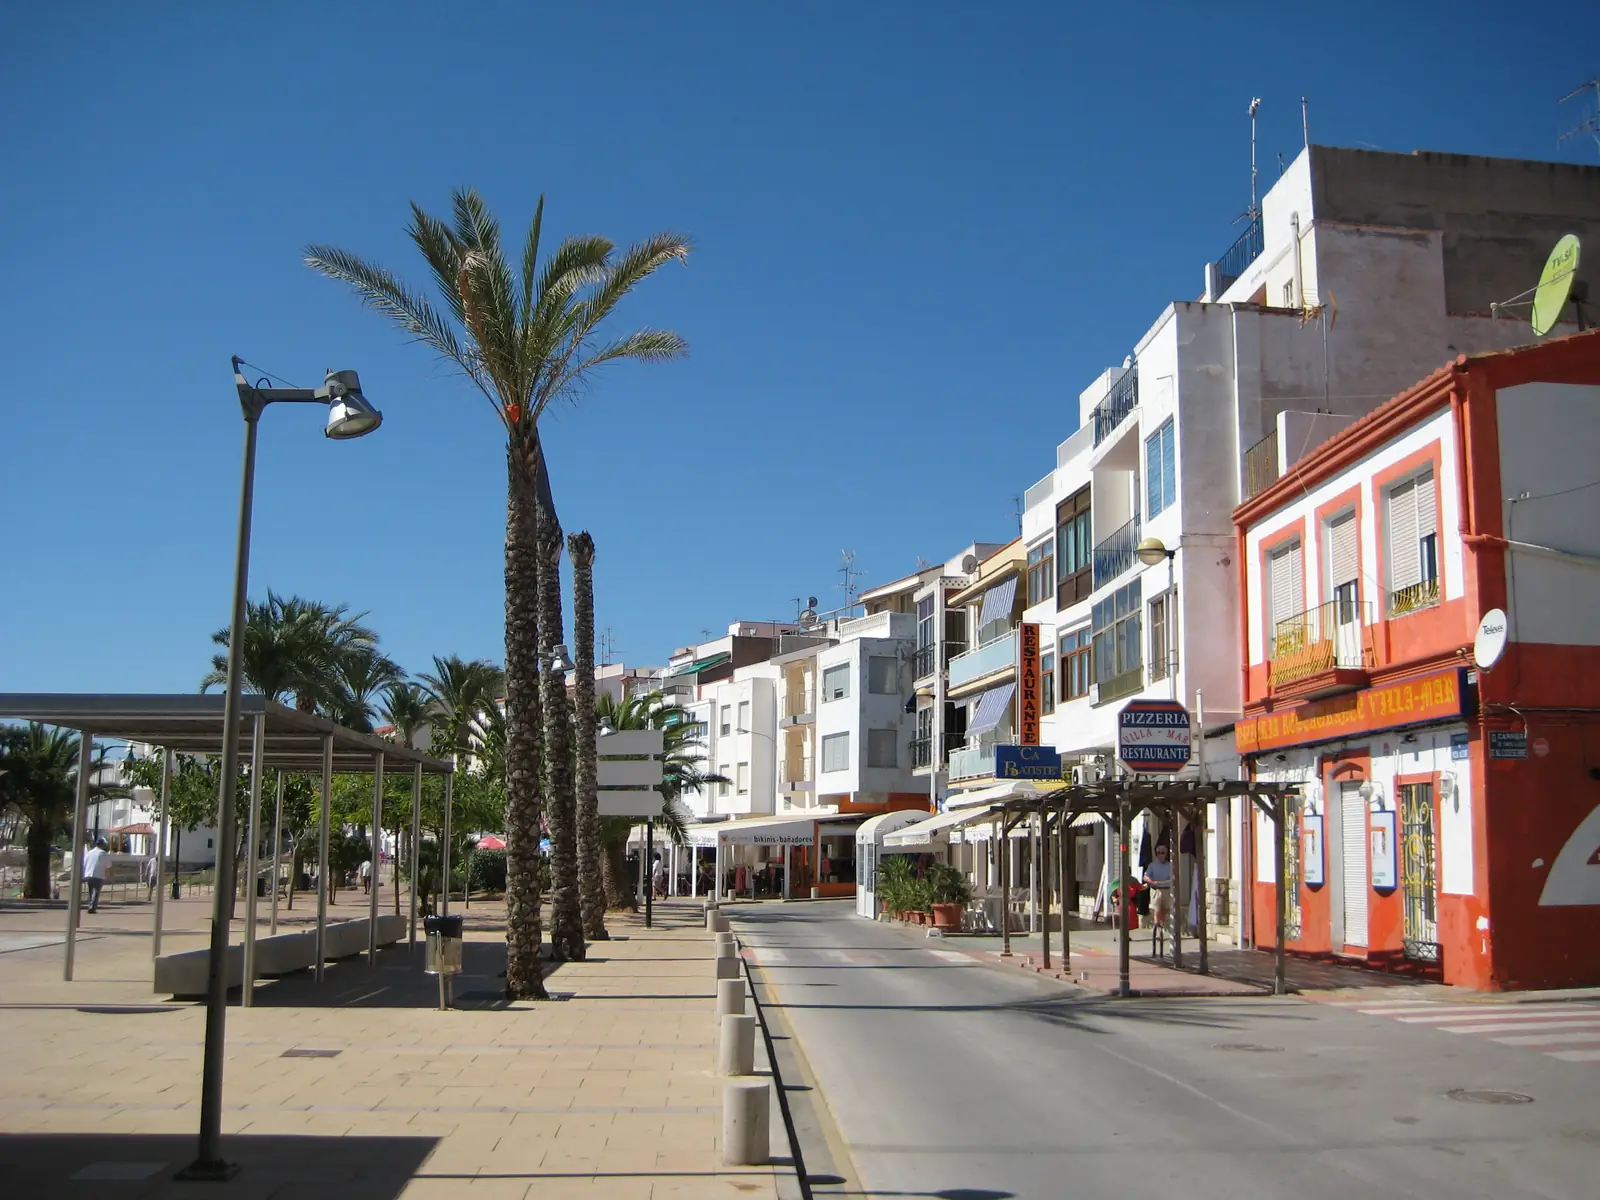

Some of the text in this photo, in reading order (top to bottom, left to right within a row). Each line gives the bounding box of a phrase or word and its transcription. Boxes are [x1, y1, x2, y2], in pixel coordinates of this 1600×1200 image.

[1023, 625, 1037, 743] RESTAURANTE
[1122, 712, 1189, 725] PIZZERIA
[1166, 727, 1189, 744] MAR
[1122, 747, 1189, 760] RESTAURANTE
